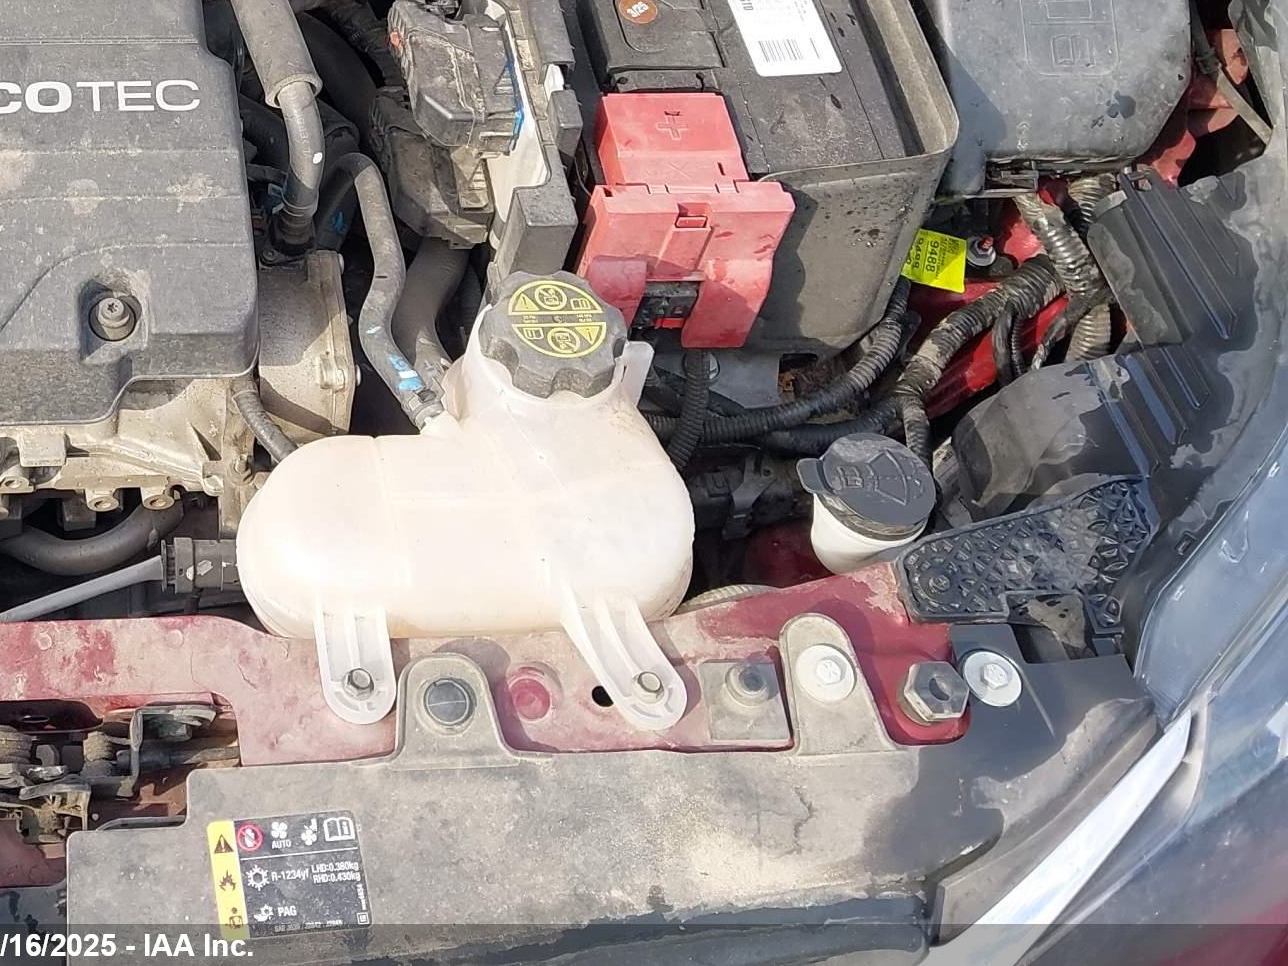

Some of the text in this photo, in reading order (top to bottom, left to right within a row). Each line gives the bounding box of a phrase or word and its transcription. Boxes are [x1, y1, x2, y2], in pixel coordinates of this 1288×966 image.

[925, 240, 940, 272] 9488
[272, 839, 292, 849] AUTO
[271, 868, 310, 881] R-1234yf
[278, 906, 297, 917] PAG
